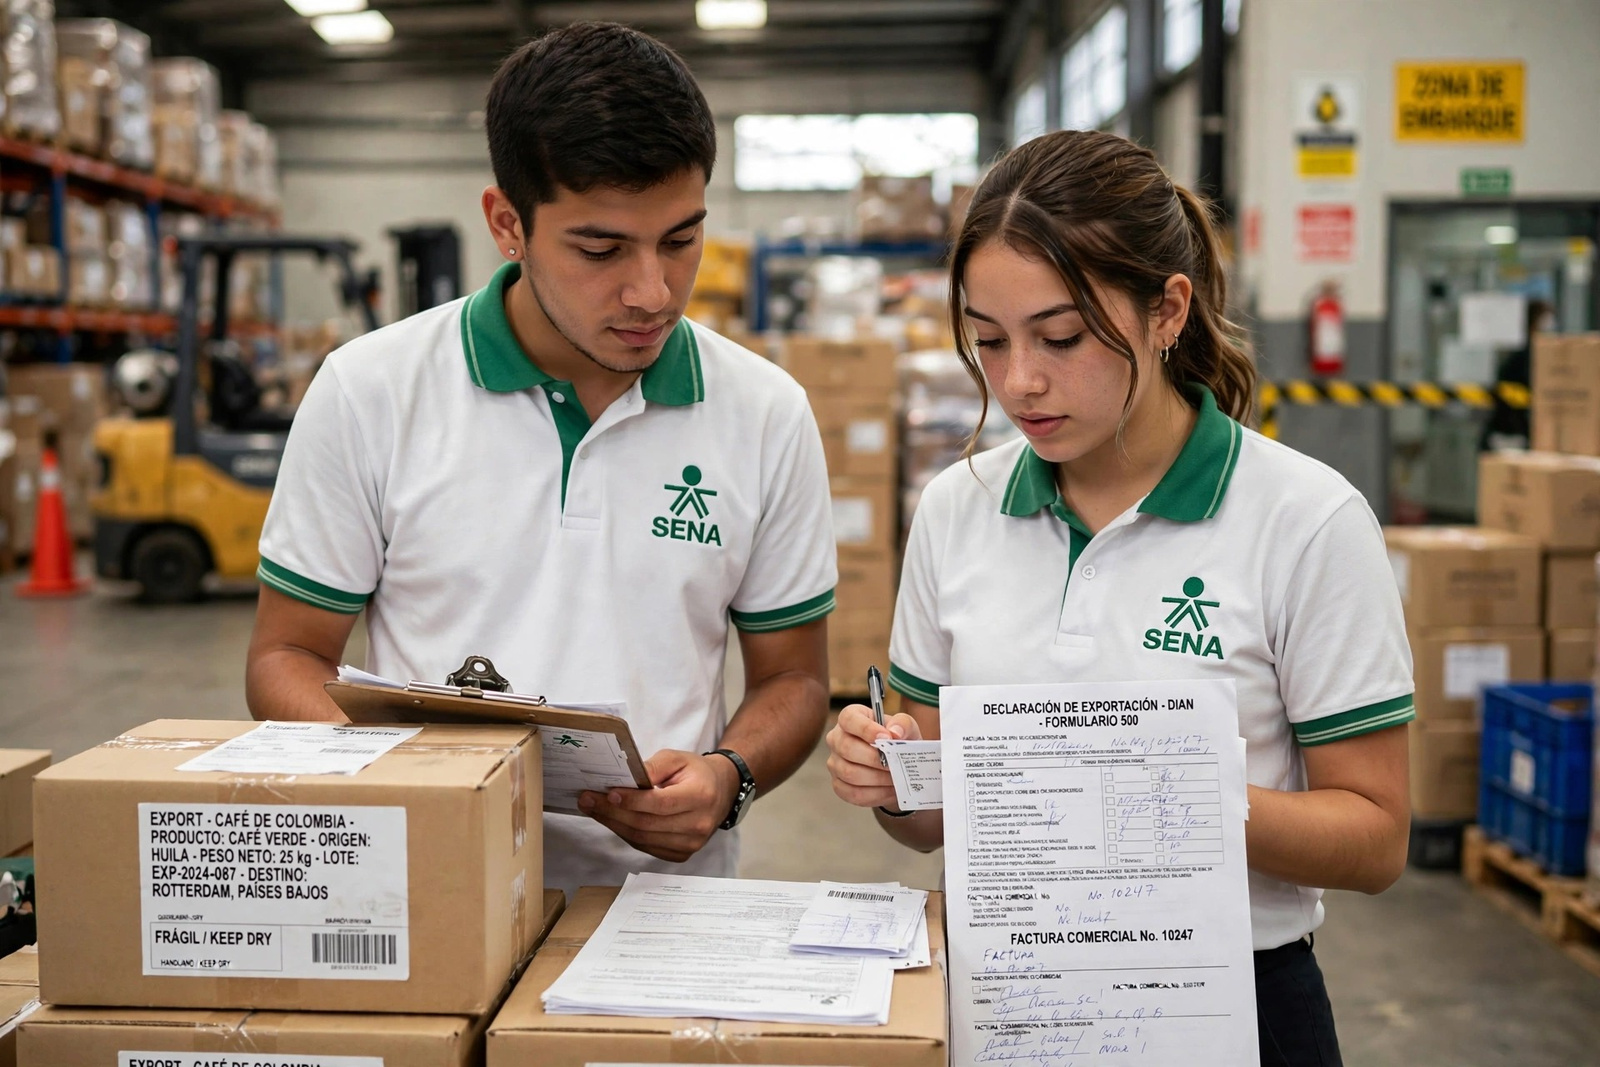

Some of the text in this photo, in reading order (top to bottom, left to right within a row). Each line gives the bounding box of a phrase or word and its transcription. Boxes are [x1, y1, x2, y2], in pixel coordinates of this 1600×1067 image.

[652, 514, 721, 546] SENA
[1143, 626, 1224, 659] SENA
[984, 700, 1060, 714] DECLARACIÓN
[1064, 702, 1078, 712] DE
[1082, 697, 1157, 712] EXPORTACIÓN
[1168, 699, 1193, 710] DIAN
[1046, 715, 1117, 727] FORMULARIO
[1121, 715, 1138, 726] 500
[151, 812, 203, 826] EXPORT
[216, 810, 249, 827] CAFÉ
[254, 813, 271, 827] DE
[276, 814, 345, 828] COLOMBIA
[151, 830, 224, 844] PRODUCTO:
[229, 829, 261, 845] CAFÉ
[265, 832, 306, 845] VERDE
[319, 833, 370, 846] ORIGEN:
[152, 848, 189, 862] HUILA
[201, 849, 234, 862] PESO
[238, 849, 275, 863] NETO:
[280, 850, 293, 863] 25
[298, 851, 311, 867] kg
[324, 851, 358, 864] LOTE:
[153, 866, 236, 880] EXP-2024-087
[249, 868, 306, 881] DESTINO:
[153, 882, 328, 900] ROTTERDAM, PAÍSES BAJOS
[156, 928, 271, 945] FRÁGIL / KEEP DRY
[1011, 929, 1193, 944] FACTURA COMERCIAL No. 10247
